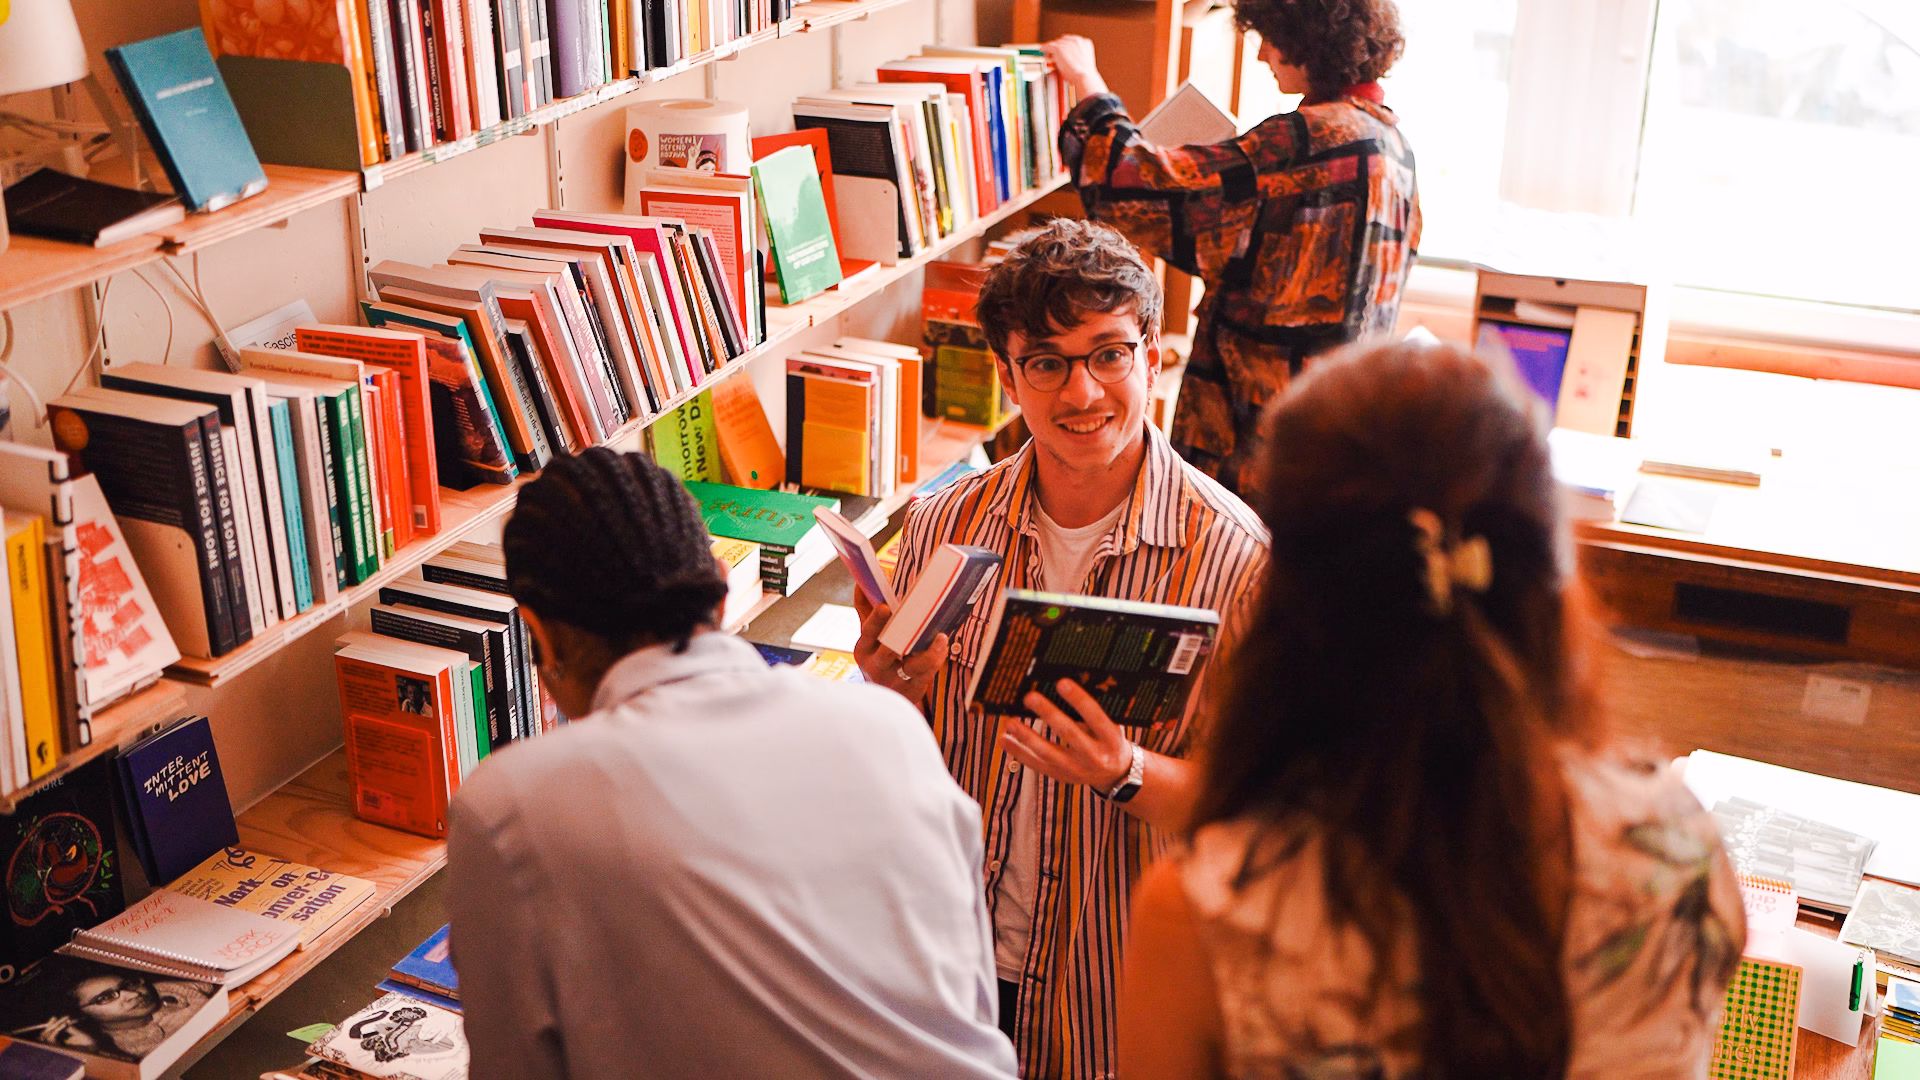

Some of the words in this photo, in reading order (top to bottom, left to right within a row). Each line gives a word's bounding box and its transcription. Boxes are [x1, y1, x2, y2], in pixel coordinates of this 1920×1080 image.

[427, 37, 437, 84] EMERGENCY
[432, 86, 442, 129] CAPITALISM
[660, 136, 693, 144] WOMEN
[660, 151, 687, 159] ROJAVA
[485, 295, 501, 322] Beatriz
[494, 320, 514, 360] Nascimento
[557, 284, 579, 325] Stronger
[574, 327, 587, 350] than
[582, 350, 597, 375] Bone
[510, 364, 520, 376] The
[350, 392, 361, 419] GAZA
[514, 376, 530, 406] Dialectic
[338, 399, 349, 426] GAZA
[529, 418, 538, 430] the
[533, 430, 542, 442] Sea
[188, 440, 207, 495] JUSTICE
[207, 431, 226, 486] JUSTICE
[197, 497, 212, 527] FOR
[216, 488, 231, 517] FOR
[202, 528, 219, 570] SOME
[221, 519, 238, 560] SOME
[144, 756, 183, 794] INTER
[155, 750, 208, 797] MITTENT
[168, 761, 211, 802] LOVE
[270, 871, 300, 889] on
[291, 884, 347, 922] sation
[212, 928, 265, 958] WORK
